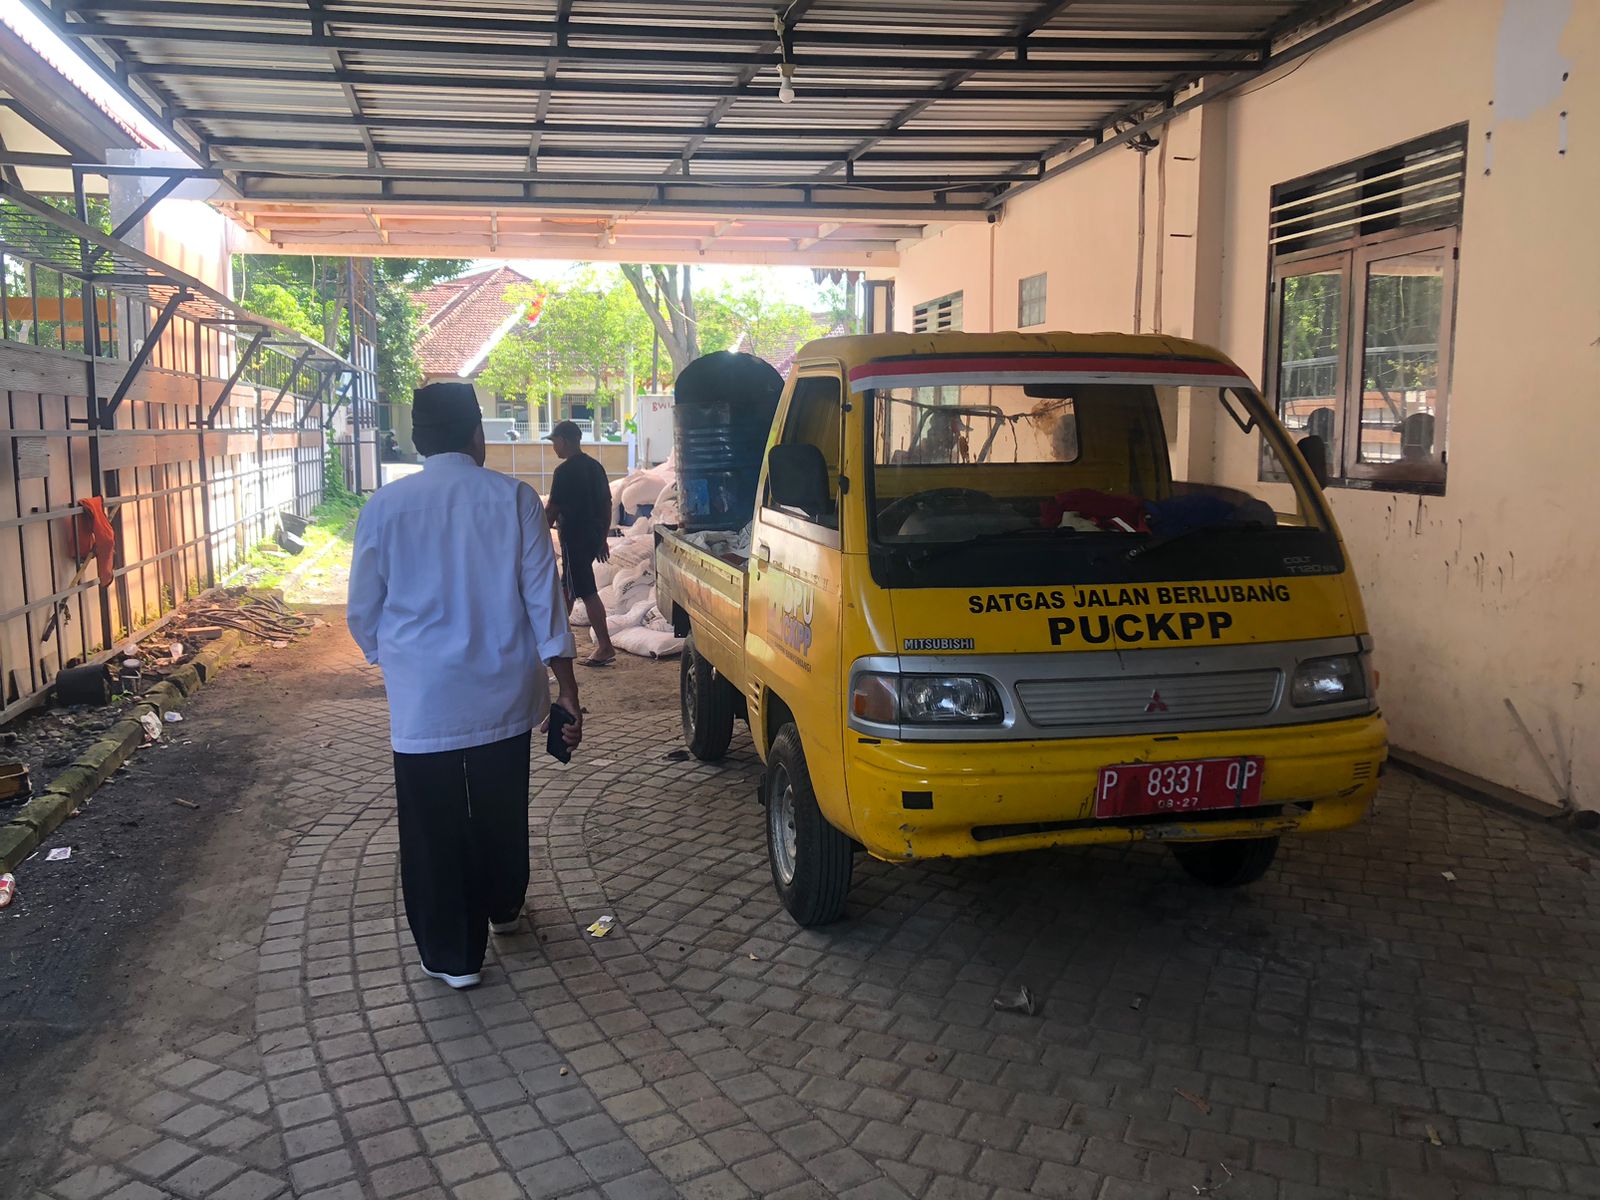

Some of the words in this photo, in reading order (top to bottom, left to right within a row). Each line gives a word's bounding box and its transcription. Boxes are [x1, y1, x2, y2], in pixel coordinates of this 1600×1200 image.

[968, 591, 1066, 614] SATGAS
[1073, 587, 1150, 608] JALAN
[1157, 584, 1290, 605] BERLUBANG
[903, 638, 975, 651] MITSUBISHI
[1047, 611, 1233, 646] PUCKPP
[1102, 770, 1118, 800] P
[1147, 764, 1204, 797] 8331
[1225, 760, 1258, 790] QP
